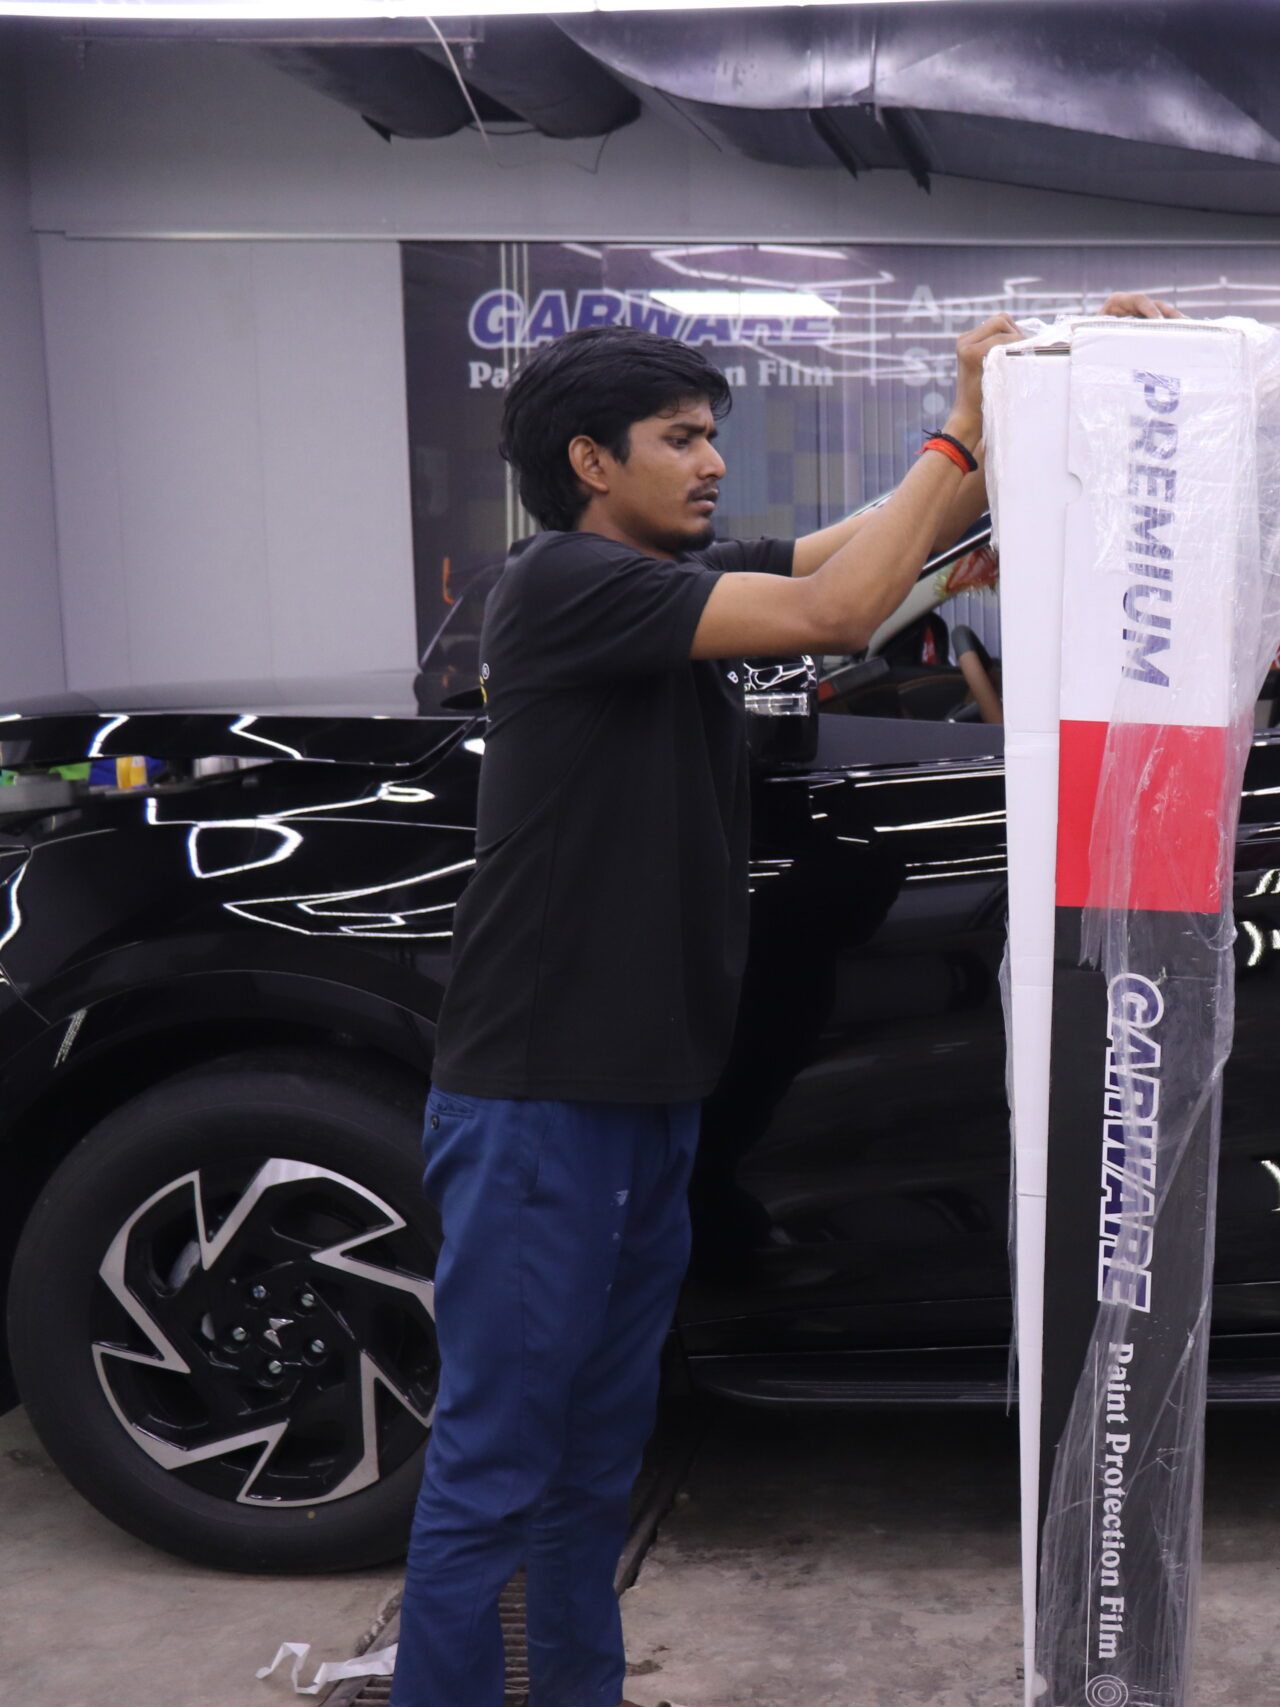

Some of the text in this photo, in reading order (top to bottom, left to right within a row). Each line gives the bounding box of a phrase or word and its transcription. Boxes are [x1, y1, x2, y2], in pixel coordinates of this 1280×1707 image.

[468, 288, 843, 350] GARWARE
[757, 359, 834, 387] Film
[1122, 369, 1181, 688] PREMIUM
[1097, 972, 1164, 1313] GARWARE
[1098, 1342, 1134, 1660] Paint Protection Film
